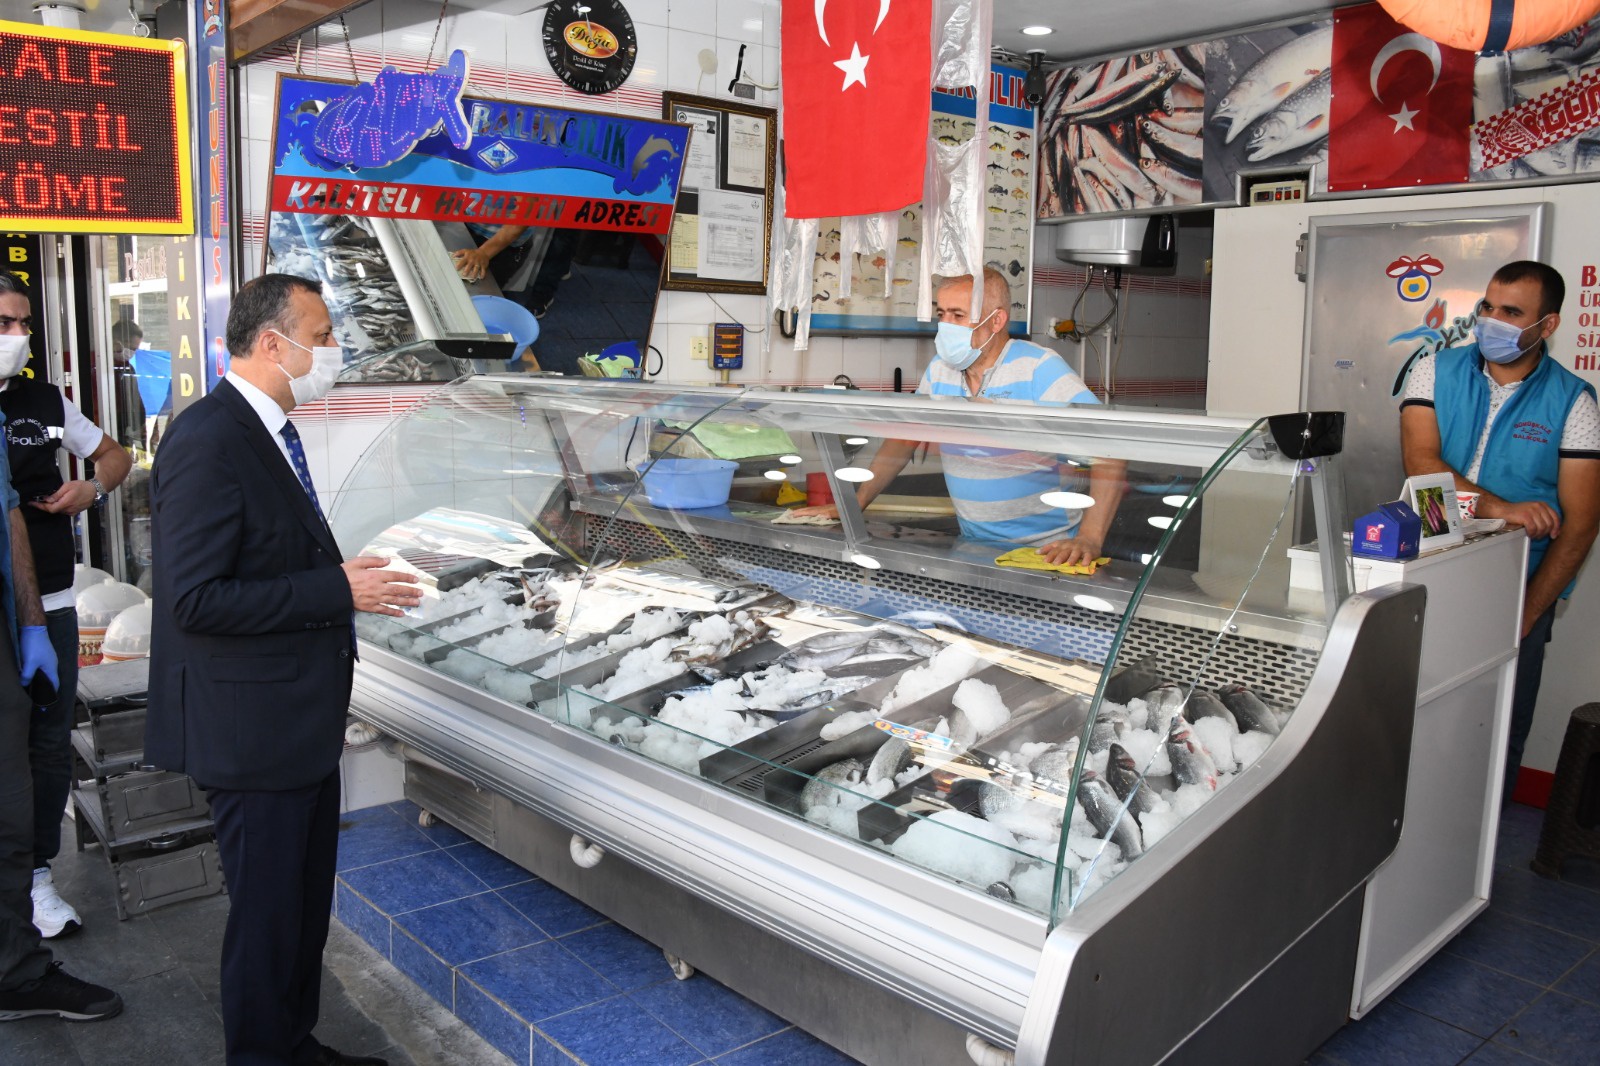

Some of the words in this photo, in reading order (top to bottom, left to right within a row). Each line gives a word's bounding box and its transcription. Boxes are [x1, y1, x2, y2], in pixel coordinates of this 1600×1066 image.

[0, 36, 118, 87] ALE
[0, 161, 128, 212] ÖME
[207, 61, 222, 286] YUNUS
[12, 435, 44, 446] POLİS
